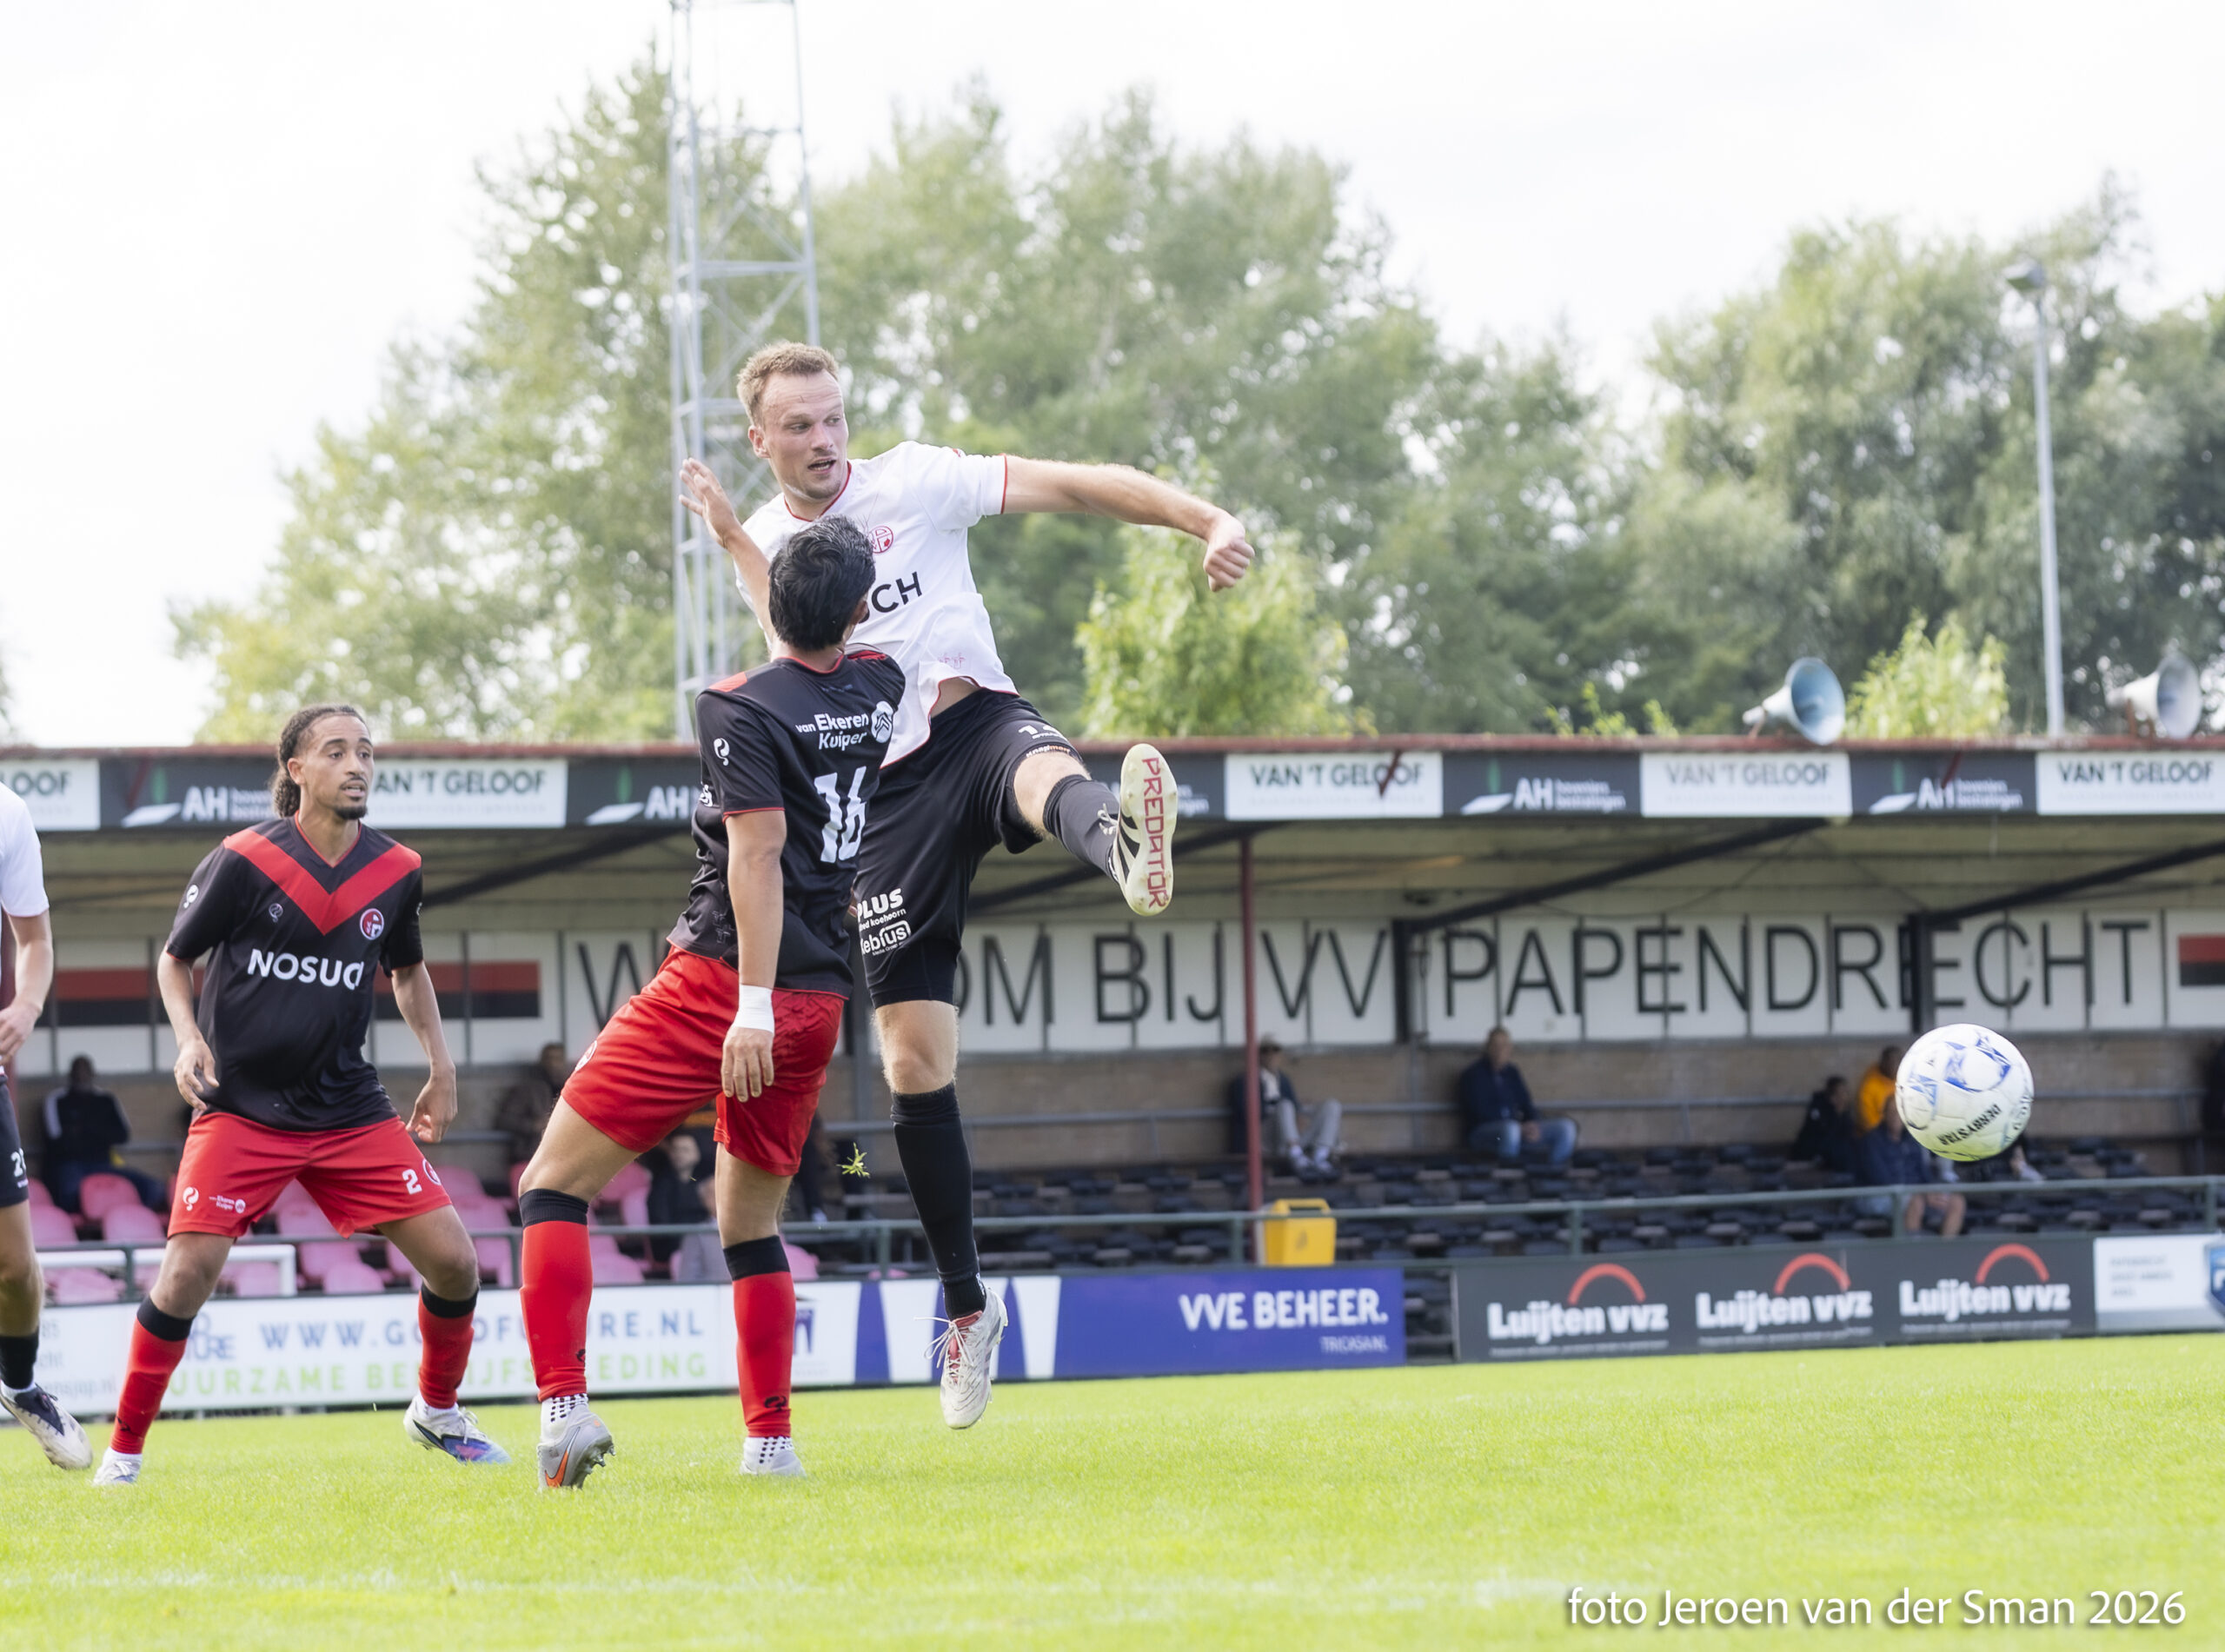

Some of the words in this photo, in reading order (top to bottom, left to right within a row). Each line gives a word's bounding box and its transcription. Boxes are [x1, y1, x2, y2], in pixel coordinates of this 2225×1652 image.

[858, 571, 922, 624] CH
[795, 723, 817, 733] van
[814, 713, 869, 731] Ekeren
[819, 731, 867, 752] Kuiper
[0, 771, 71, 796] OOF
[371, 772, 411, 794] AN
[443, 769, 546, 794] GELOOF
[1249, 763, 1303, 787] VAN
[1330, 762, 1425, 788] GELOOF
[1664, 761, 1716, 786] VAN
[1742, 761, 1832, 786] GELOOF
[2058, 761, 2104, 784] VAN
[2130, 760, 2214, 784] GELOOF
[182, 785, 229, 821] AH
[643, 785, 689, 819] AH
[1513, 776, 1553, 811] AH
[814, 766, 867, 864] 16
[1142, 757, 1171, 909] PREDATOR
[1093, 930, 1222, 1024] BIJ
[1260, 929, 1388, 1020] VV
[1442, 919, 2152, 1018] PAPENDRECHT
[402, 1169, 422, 1195] 2
[1252, 1287, 1390, 1330] BEHEER.
[1695, 1288, 1811, 1334] Luijten
[1812, 1290, 1874, 1320] vvz
[1898, 1277, 2010, 1322] Luijten
[2012, 1282, 2072, 1312] vvz
[1487, 1300, 1606, 1345] Luijten
[1606, 1303, 1670, 1333] vvz
[169, 1364, 345, 1397] UURZAME
